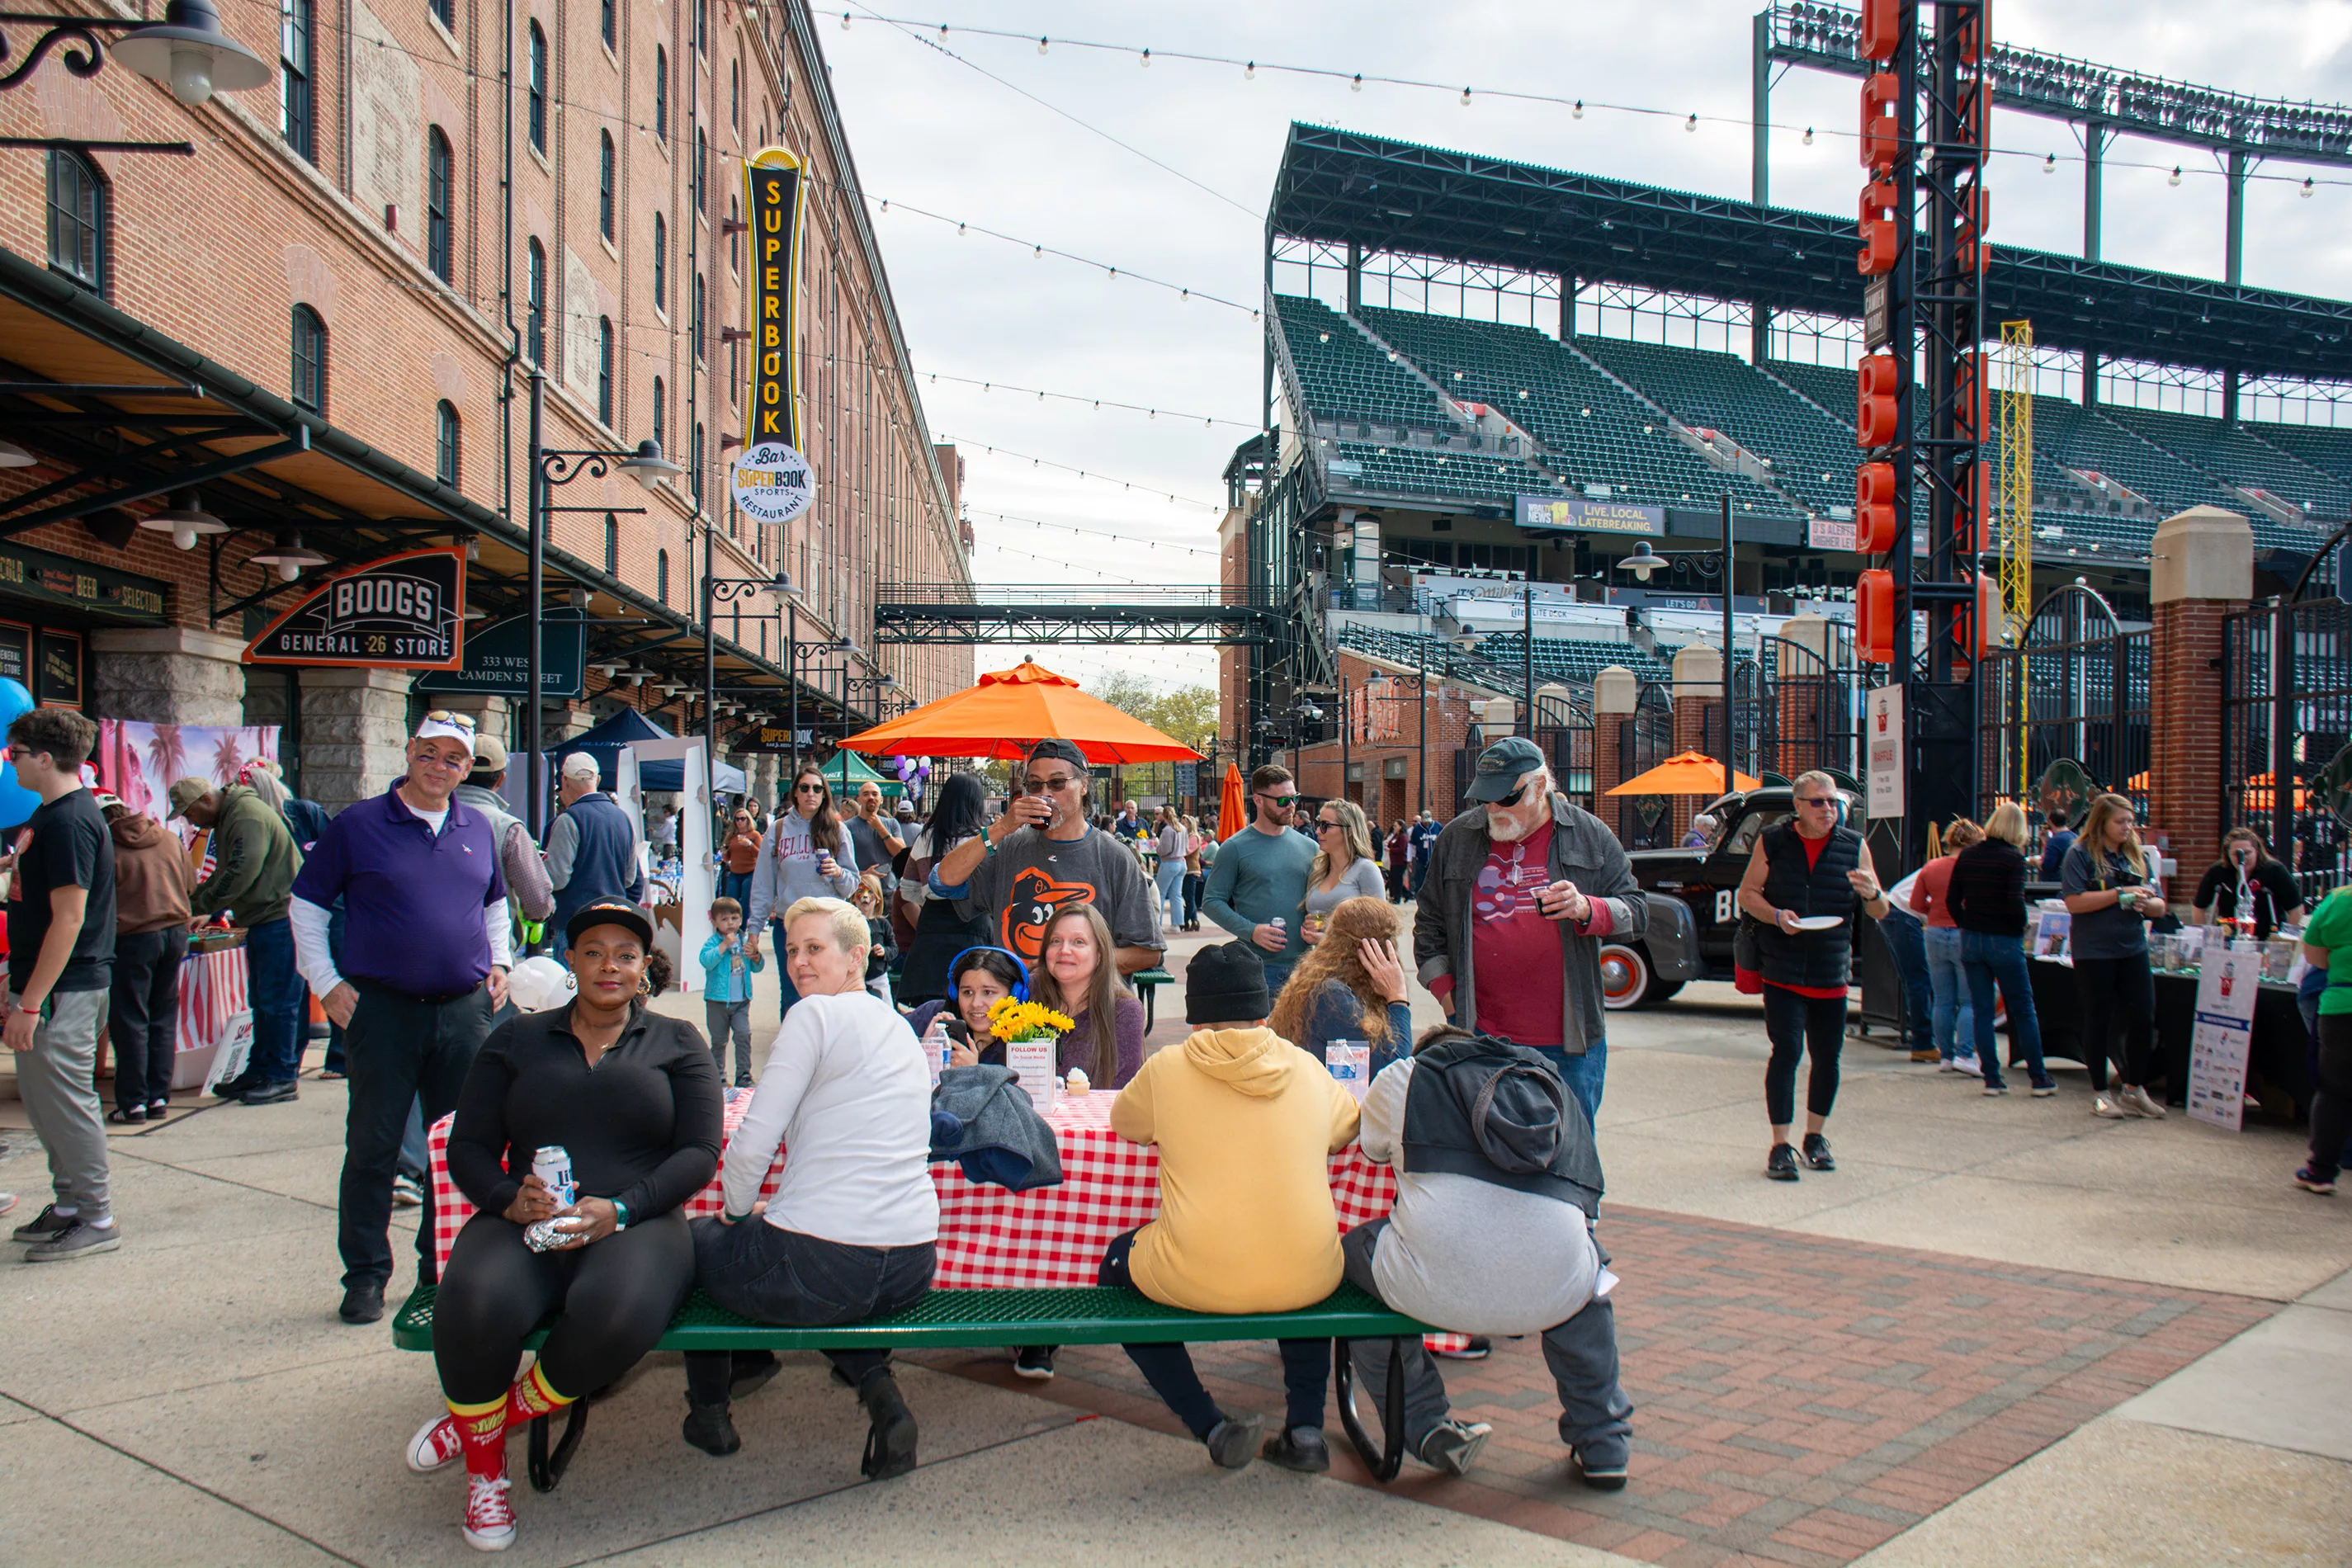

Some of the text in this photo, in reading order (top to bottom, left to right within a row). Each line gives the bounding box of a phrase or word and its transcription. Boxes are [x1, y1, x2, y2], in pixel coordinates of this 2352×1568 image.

[763, 180, 782, 434] SUPERBOOK
[754, 446, 788, 465] Bar
[737, 468, 807, 489] SUPERBOOK
[754, 488, 790, 496] SPORTS
[740, 494, 804, 519] RESTAURANT
[1527, 511, 1551, 524] NEWS
[76, 574, 98, 600] BEER
[121, 585, 163, 615] SELECTION
[337, 579, 433, 621] BOOG'S
[1665, 598, 1697, 609] LET'S GO
[281, 634, 360, 654] GENERAL
[394, 638, 450, 657] STORE
[482, 656, 529, 668] 333 WES
[457, 670, 563, 684] CAMDEN STEET
